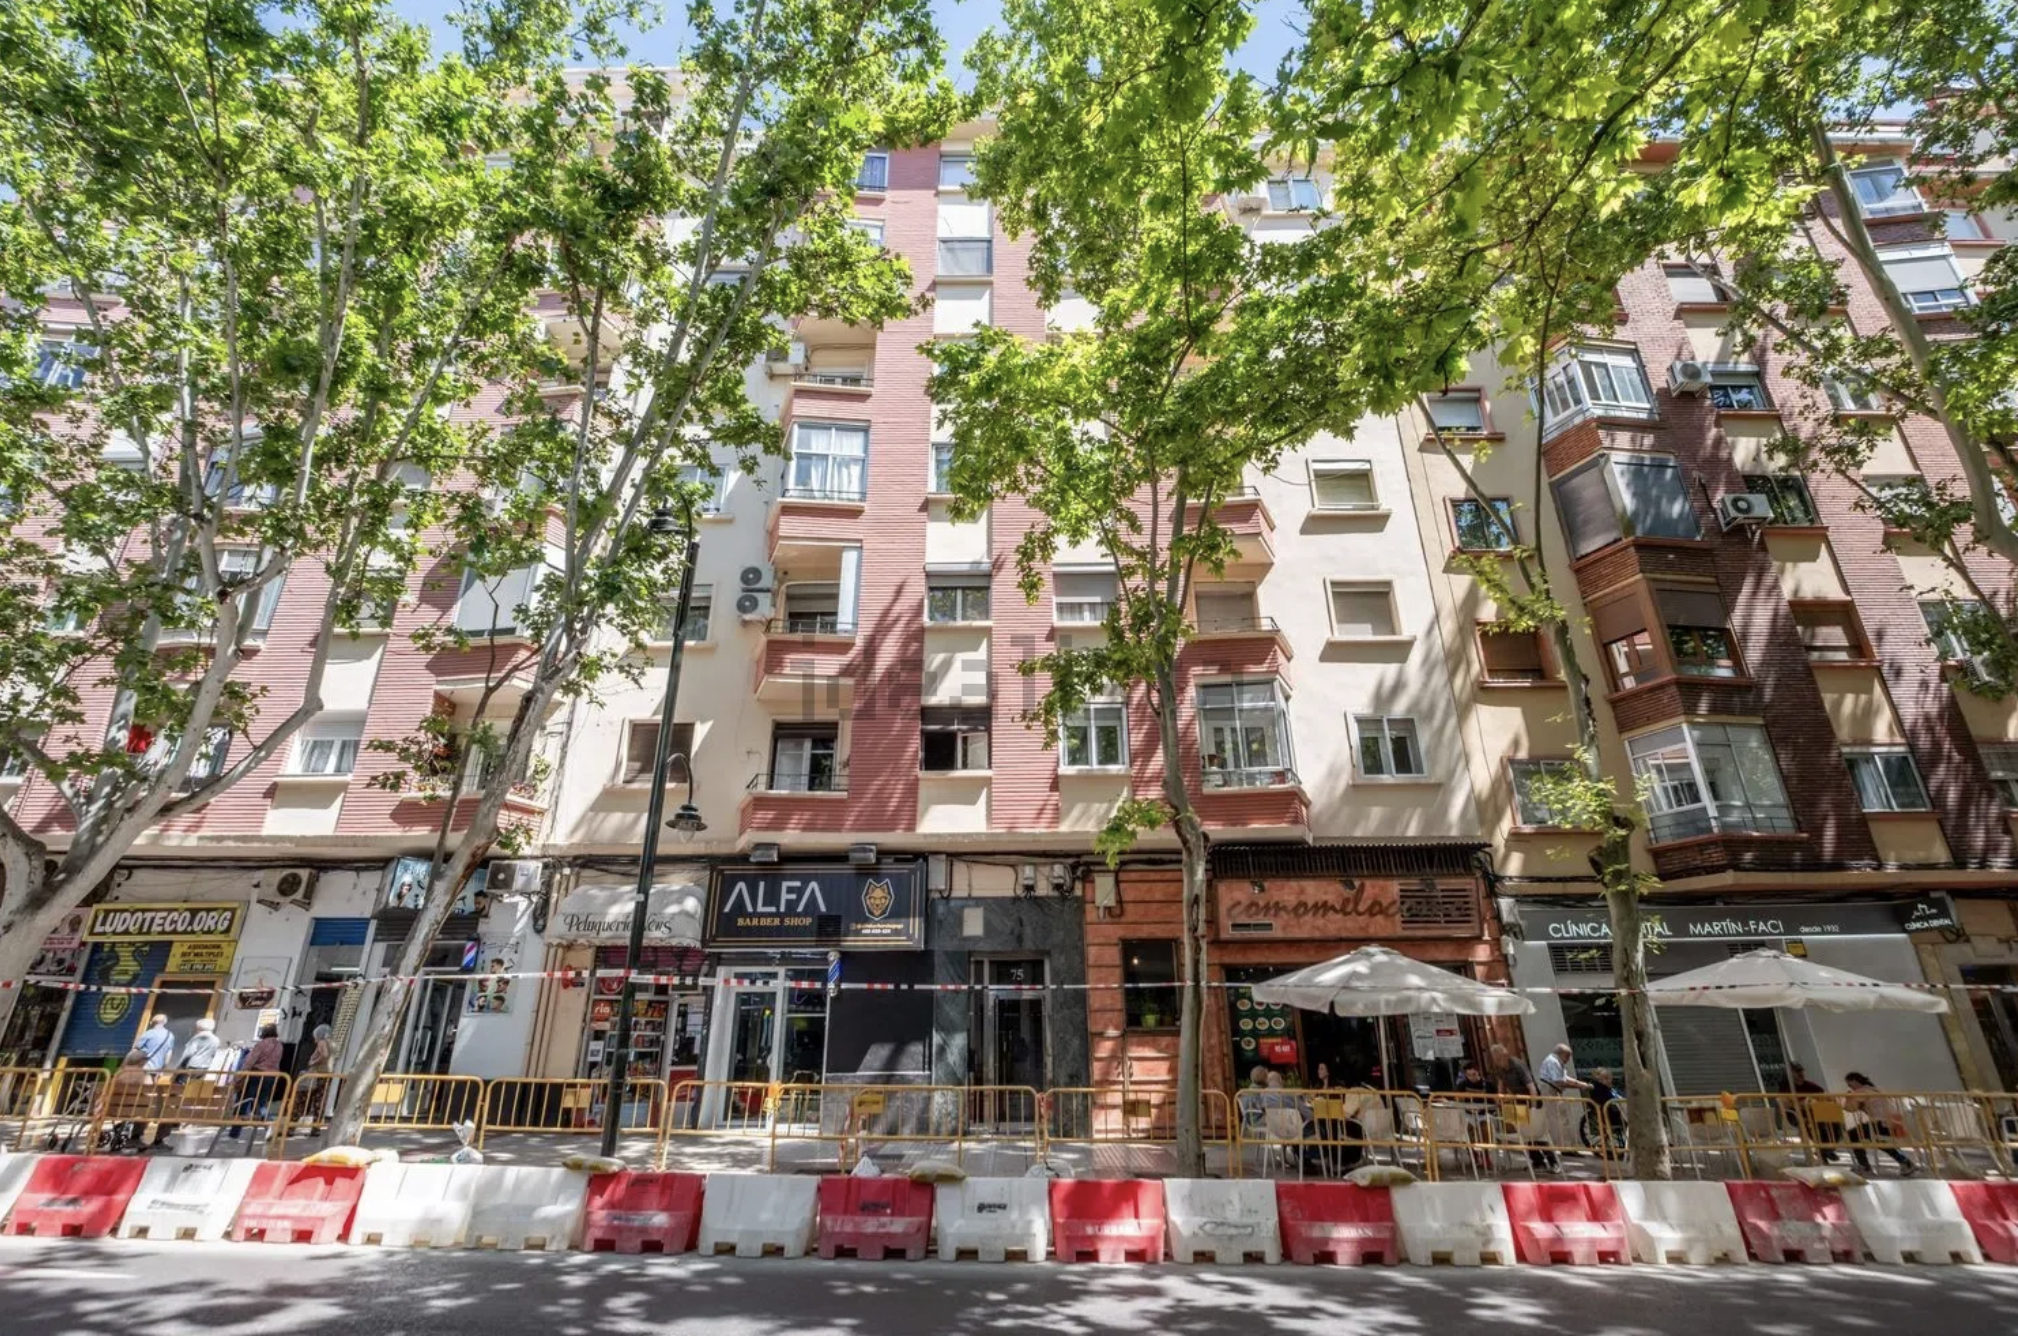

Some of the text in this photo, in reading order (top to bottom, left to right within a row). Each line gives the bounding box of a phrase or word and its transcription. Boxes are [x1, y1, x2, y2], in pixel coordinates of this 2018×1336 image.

[723, 880, 827, 913] ALFA
[93, 910, 232, 933] LUDOTECO.ORG
[736, 916, 813, 927] BARBER SHOP
[1548, 920, 1612, 937] CLÍNICA
[1689, 917, 1784, 936] MARTÍN-FACI
[1799, 925, 1822, 933] desde
[1010, 968, 1024, 981] 75
[594, 1002, 610, 1013] ria
